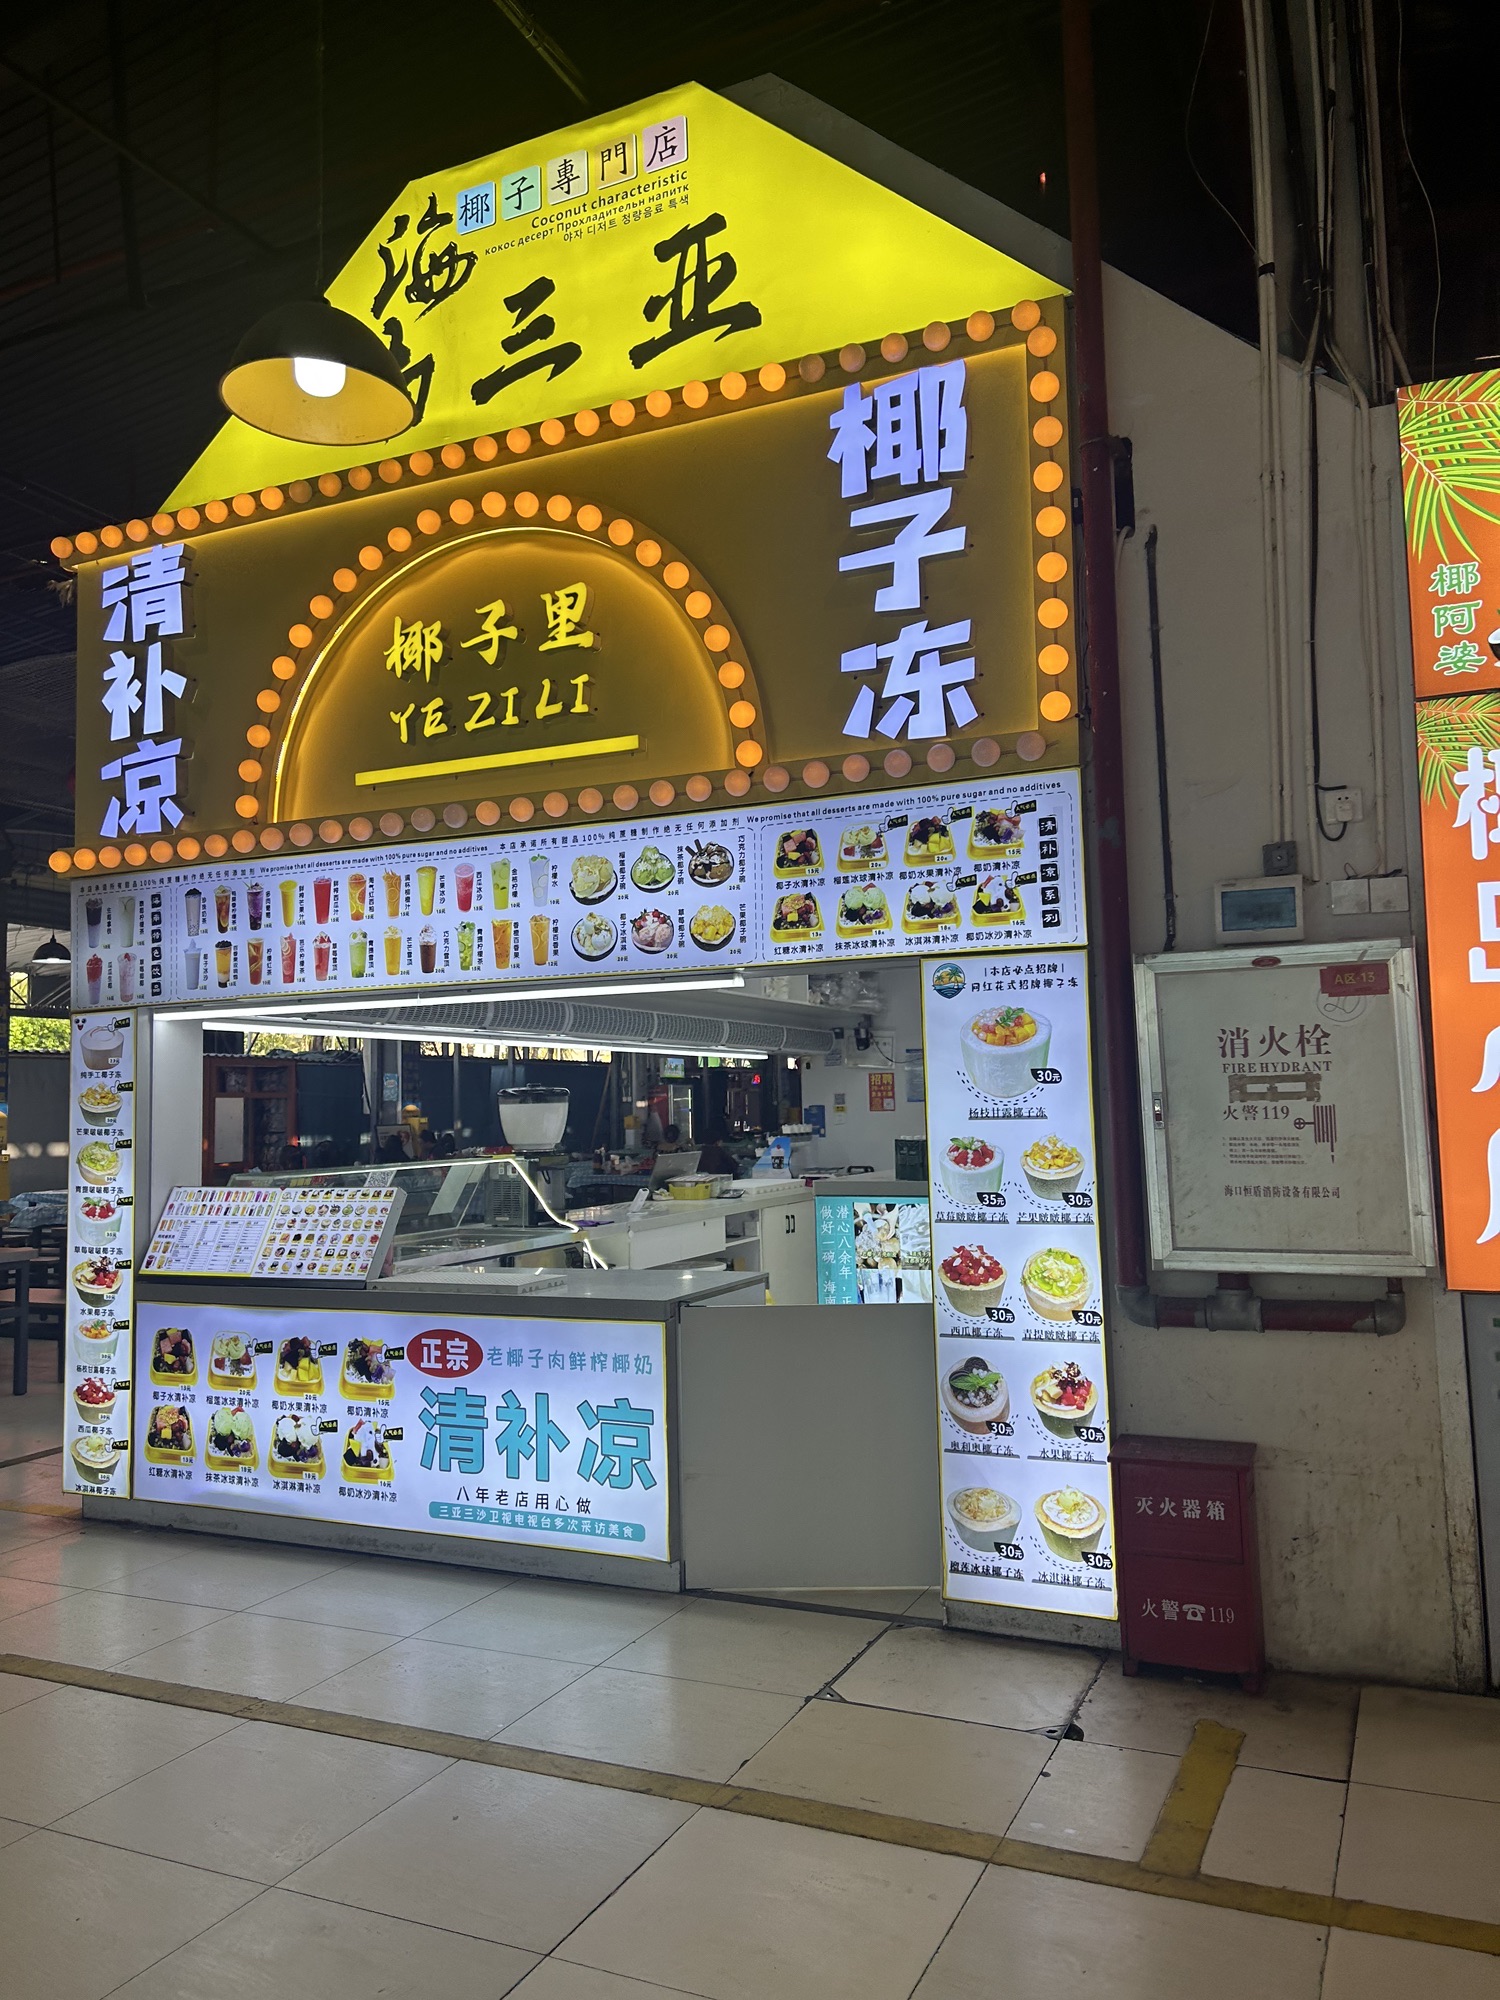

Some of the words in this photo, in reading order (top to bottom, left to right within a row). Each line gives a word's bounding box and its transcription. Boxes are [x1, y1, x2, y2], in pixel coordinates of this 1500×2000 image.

[458, 125, 678, 228] 椰子專門店
[531, 203, 587, 229] Coconut
[591, 170, 688, 210] characteristic
[485, 239, 515, 256] кокос
[517, 227, 554, 247] десерт
[556, 199, 645, 232] Прохладительн
[648, 184, 689, 207] напитк
[563, 229, 584, 243] 야자
[587, 219, 617, 236] 디저트
[622, 204, 664, 225] 청량음료
[668, 194, 689, 211] 특색
[470, 212, 762, 406] 三亚
[827, 358, 979, 740] 椰子冻
[1429, 561, 1487, 676] 椰阿婆
[384, 582, 594, 683] 椰子里
[101, 543, 187, 838] 清补凉
[746, 815, 759, 824] We
[760, 811, 792, 824] promise
[793, 809, 809, 819] that
[811, 807, 821, 817] all
[822, 804, 856, 815] desserts
[857, 803, 870, 812] are
[871, 799, 894, 810] made
[896, 796, 915, 807] with
[917, 794, 939, 805] 100%
[940, 792, 961, 803] pure
[962, 789, 987, 801] sugar
[988, 787, 1005, 797] and
[1007, 786, 1018, 795] no
[1019, 780, 1062, 793] additives
[260, 866, 270, 874] We
[270, 863, 293, 874] promise
[294, 862, 306, 870] that
[315, 859, 340, 868] desserts
[341, 858, 351, 866] are
[352, 856, 369, 865] made
[369, 854, 384, 863] with
[385, 852, 401, 861] 100%
[402, 851, 416, 861] pure
[417, 849, 435, 860] sugar
[436, 848, 448, 857] and
[449, 848, 457, 856] no
[458, 845, 488, 855] additives
[738, 835, 746, 883] 巧克力椰子碗
[973, 860, 1021, 873] 椰奶清补凉
[833, 871, 894, 885] 榴莲冰球清补凉
[898, 866, 962, 881] 椰奶水果清补凉
[1040, 821, 1060, 924] 清补凉系列
[775, 877, 826, 890] 椰子水清补凉
[739, 903, 747, 944] 芒果椰子碗
[904, 933, 959, 946] 冰淇淋清补凉
[965, 928, 1033, 942] 椰奶冰沙清补凉
[773, 943, 824, 956] 红糖水清补凉
[834, 938, 896, 951] 抹茶冰球清补凉
[989, 963, 1058, 977] 本店必点招牌
[971, 977, 1079, 993] 网红花式招牌椰子冻
[1334, 971, 1376, 985] A区-13
[1217, 1023, 1332, 1059] 消火栓
[80, 1070, 122, 1079] 纯手工椰子冻
[1222, 1062, 1257, 1074] FIRE
[1260, 1060, 1333, 1074] HYDRANT
[1036, 1070, 1061, 1083] 30元
[968, 1106, 1047, 1120] 杨枝甘露椰子冻
[1223, 1104, 1290, 1121] 火警119
[1224, 1184, 1340, 1199] 海口恒盾消防设备有限公司
[982, 1194, 1006, 1207] 35元
[1067, 1194, 1092, 1207] 30元
[79, 1308, 115, 1317] 水果椰子冻
[991, 1308, 1014, 1322] 30元
[1077, 1312, 1101, 1325] 30元
[950, 1326, 1003, 1338] 西瓜椰子冻
[420, 1337, 469, 1371] 正宗
[486, 1346, 653, 1376] 老椰子肉鲜榨椰奶
[152, 1391, 196, 1403] 椰子水清补凉
[206, 1395, 259, 1408] 榴莲冰球清补凉
[271, 1400, 328, 1414] 椰奶水果清补凉
[346, 1405, 389, 1418] 椰奶清补凉
[77, 1424, 113, 1435] 西瓜椰子冻
[990, 1422, 1013, 1436] 30元
[1080, 1428, 1104, 1442] 30元
[418, 1385, 657, 1491] 清补凉
[950, 1440, 1014, 1457] 奥利奥椰子冻
[1039, 1448, 1095, 1463] 水果椰子冻
[148, 1466, 193, 1480] 红糖水清补凉
[205, 1472, 259, 1487] 抹茶冰球清补凉
[272, 1479, 321, 1493] 冰淇淋清补凉
[338, 1486, 398, 1502] 椰奶冰沙清补凉
[456, 1485, 592, 1514] 八年老店用心做
[1134, 1496, 1226, 1521] 灭火器箱
[438, 1505, 634, 1538] 三亚三沙卫视电视台多次采访美食
[1000, 1544, 1023, 1559] 30元
[1087, 1554, 1112, 1568] 30元
[949, 1560, 1024, 1580] 榴莲冰球椰子冻
[1038, 1571, 1106, 1589] 冰淇淋椰子冻
[1141, 1598, 1180, 1621] 火警
[1209, 1606, 1235, 1624] 119
